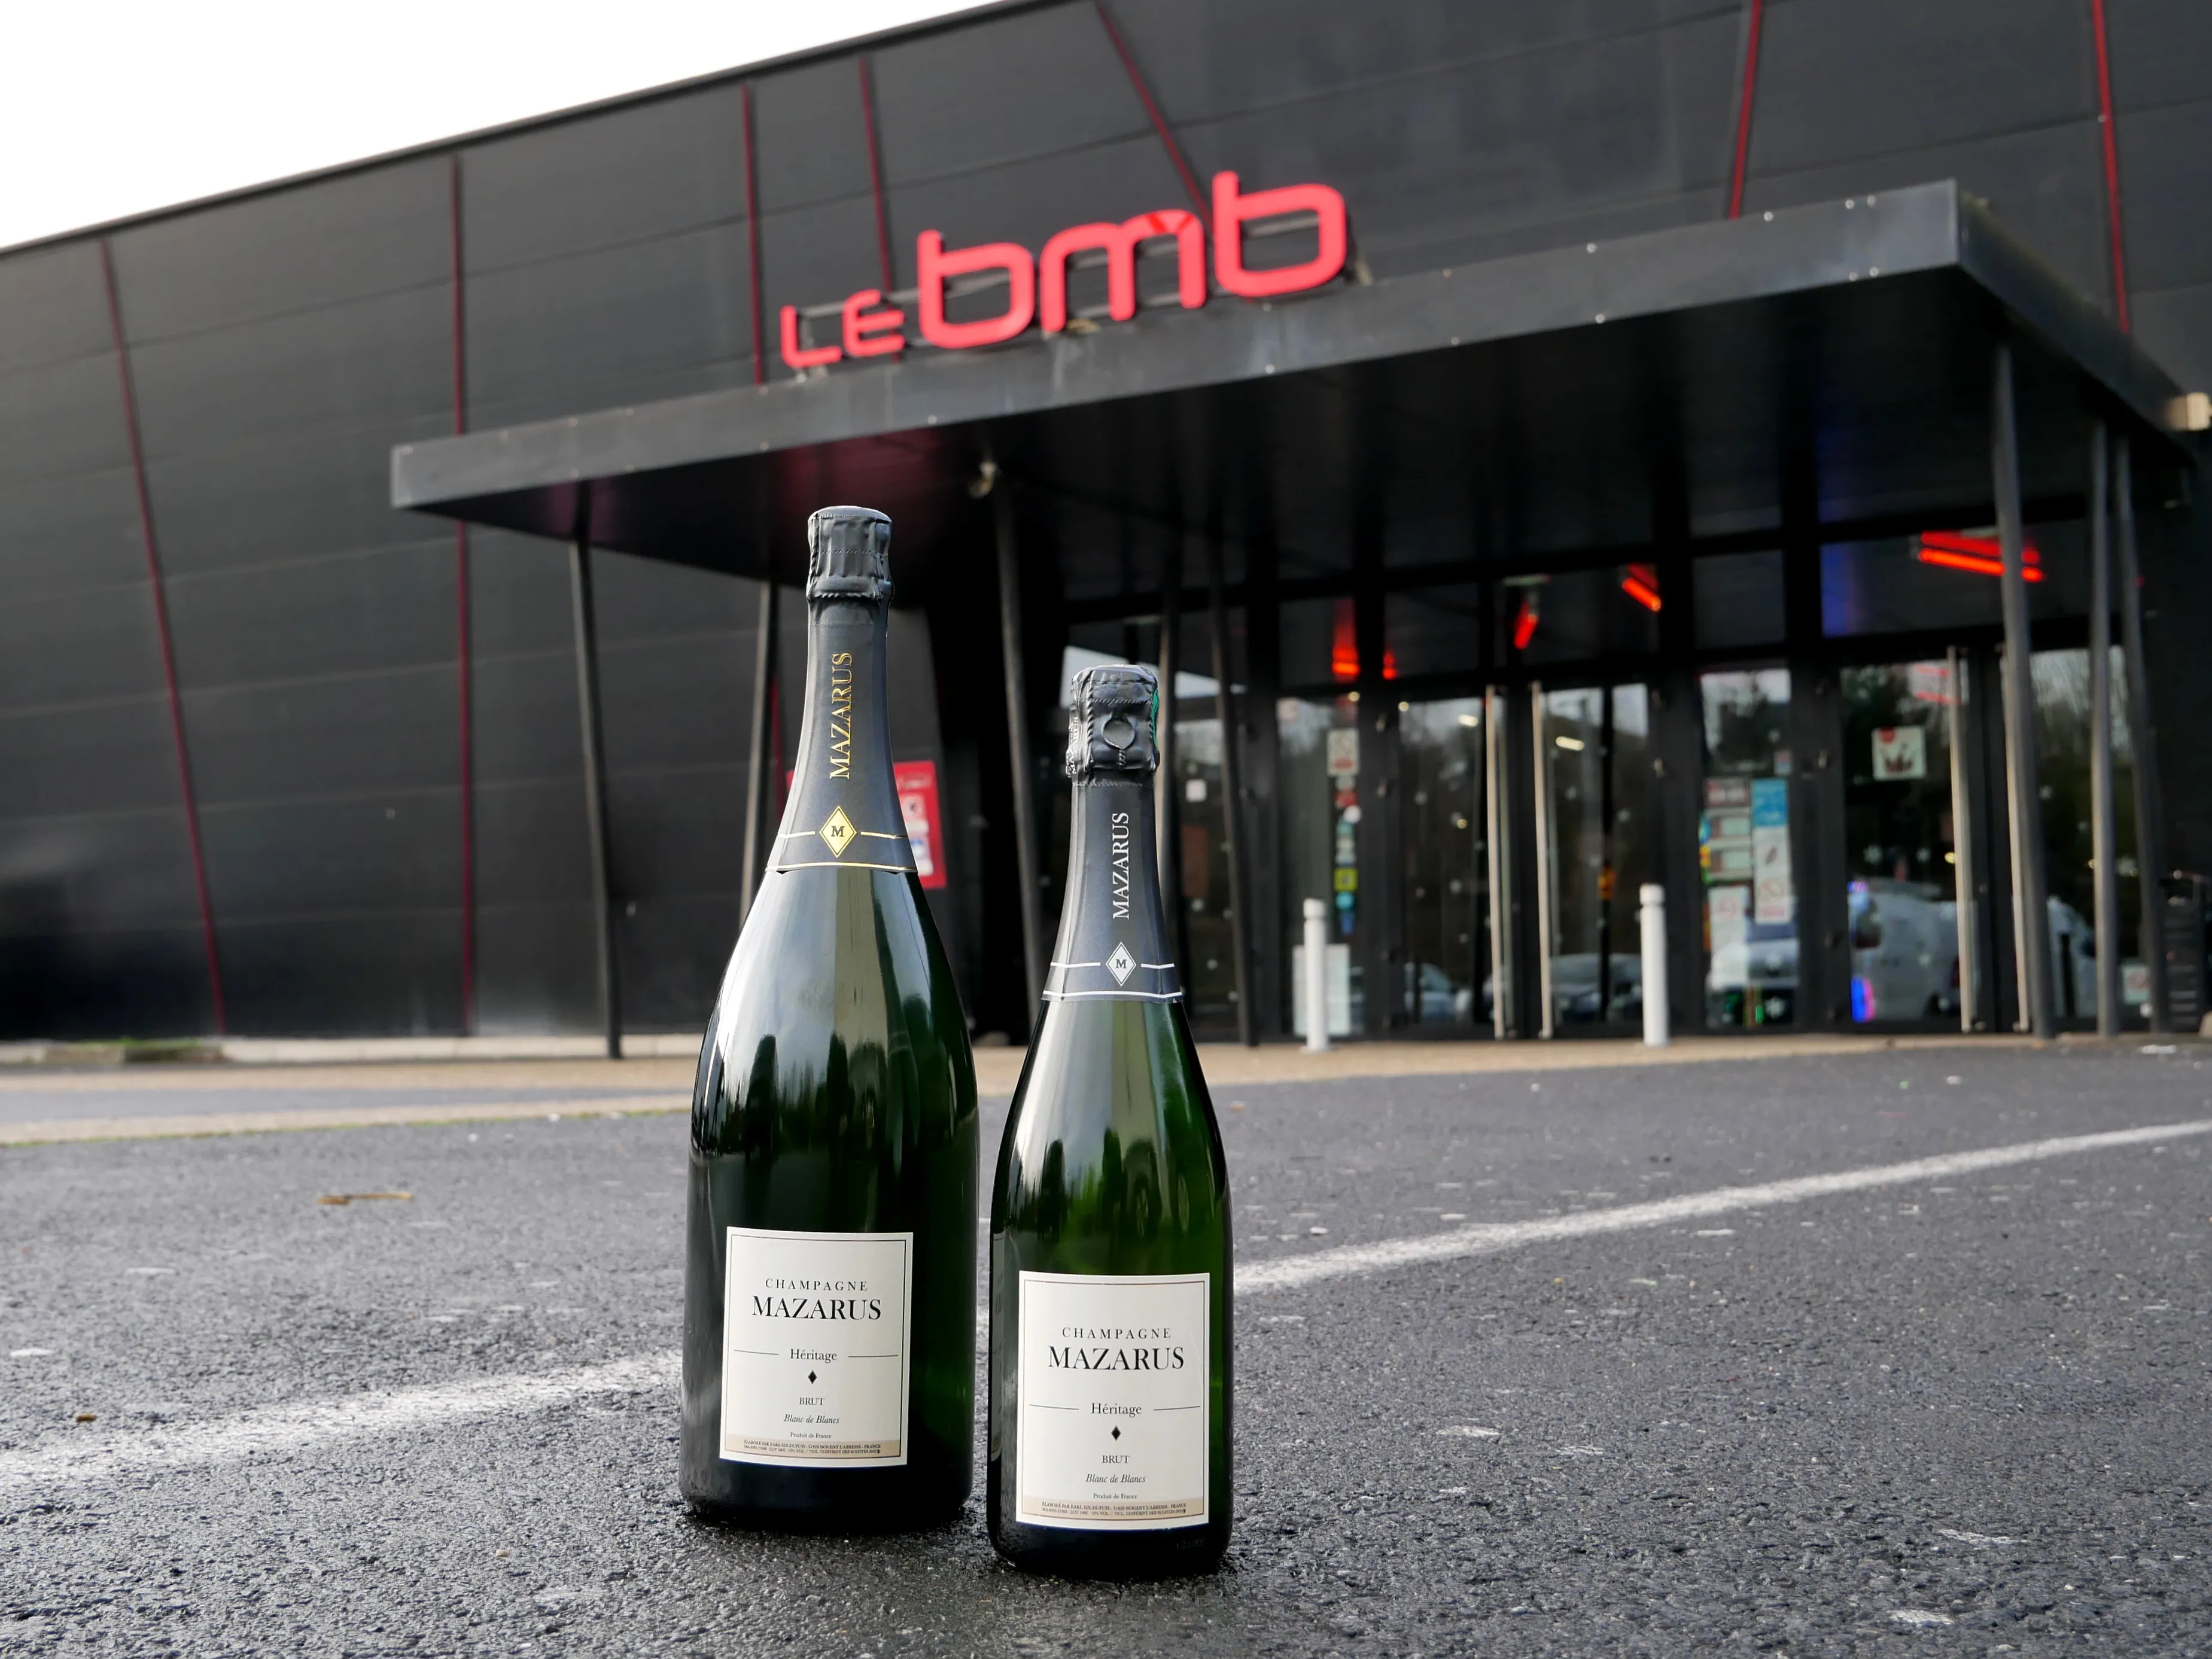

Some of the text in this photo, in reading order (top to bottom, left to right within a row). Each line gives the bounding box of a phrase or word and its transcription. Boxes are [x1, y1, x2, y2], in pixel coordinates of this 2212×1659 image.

[780, 171, 1346, 369] LE bmb
[829, 652, 853, 780] MAZARUS
[830, 826, 845, 838] M
[1112, 812, 1130, 920] MAZARUS
[1115, 959, 1127, 969] M
[765, 1278, 868, 1291] CHAMPAGNE
[752, 1295, 881, 1320] MAZARUS
[1063, 1328, 1171, 1339] CHAMPAGNE
[790, 1348, 837, 1363] Héritage
[1048, 1346, 1184, 1370] MAZARUS
[799, 1397, 824, 1405] BRUT
[1091, 1403, 1142, 1418] Héritage
[783, 1414, 839, 1424] Blanc de Blancs
[1102, 1455, 1130, 1463] BRUT
[1086, 1474, 1145, 1483] Blanc de Blancs
